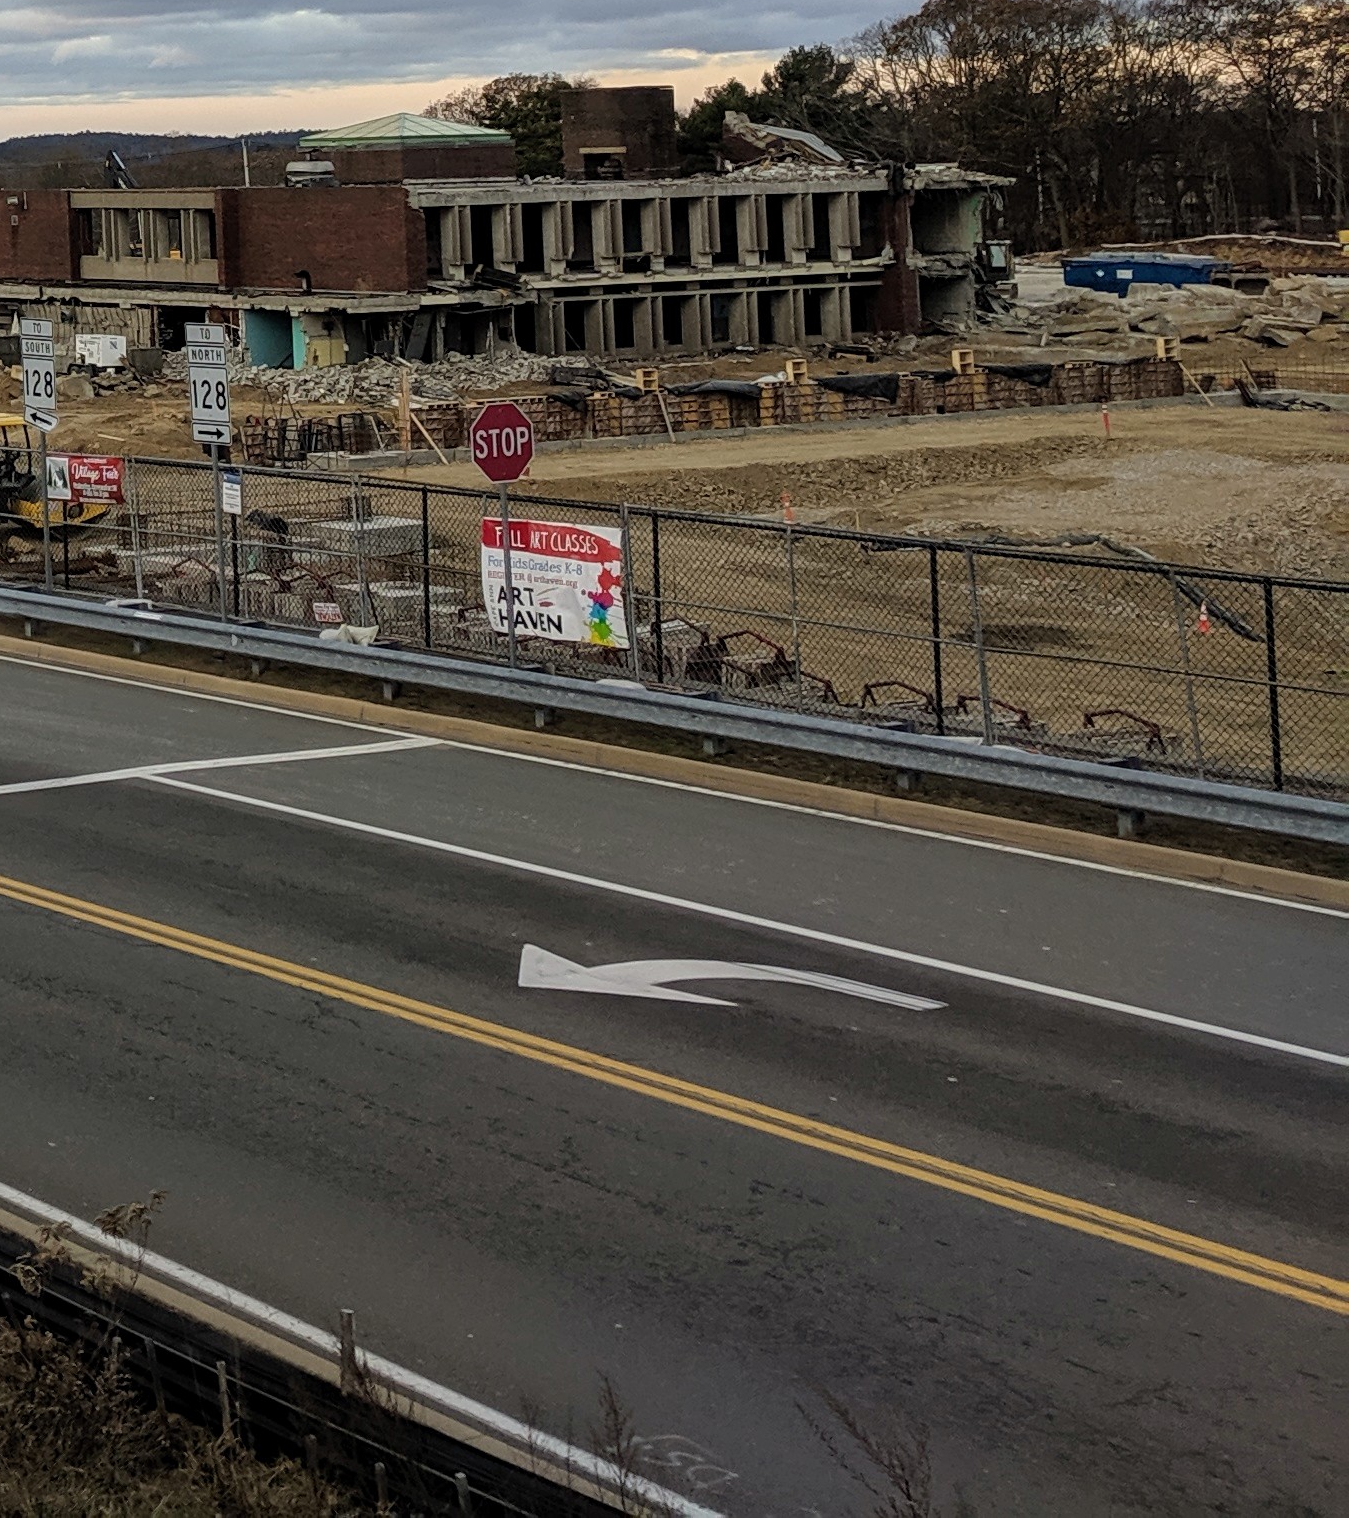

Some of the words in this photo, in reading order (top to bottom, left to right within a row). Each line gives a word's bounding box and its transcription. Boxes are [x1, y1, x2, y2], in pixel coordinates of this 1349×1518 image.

[32, 323, 42, 334] TO
[199, 328, 211, 340] TO
[24, 342, 51, 354] SOUTH
[191, 349, 222, 362] NORTH
[24, 369, 54, 399] 128
[192, 380, 227, 411] 128
[475, 426, 529, 460] STOP
[495, 526, 526, 548] FLL
[530, 530, 548, 550] ART
[550, 532, 599, 555] CLASSES
[487, 555, 503, 568] For
[528, 559, 562, 573] Grades
[564, 562, 583, 575] K-8
[497, 585, 535, 607] ART
[498, 608, 563, 635] HAVEN
